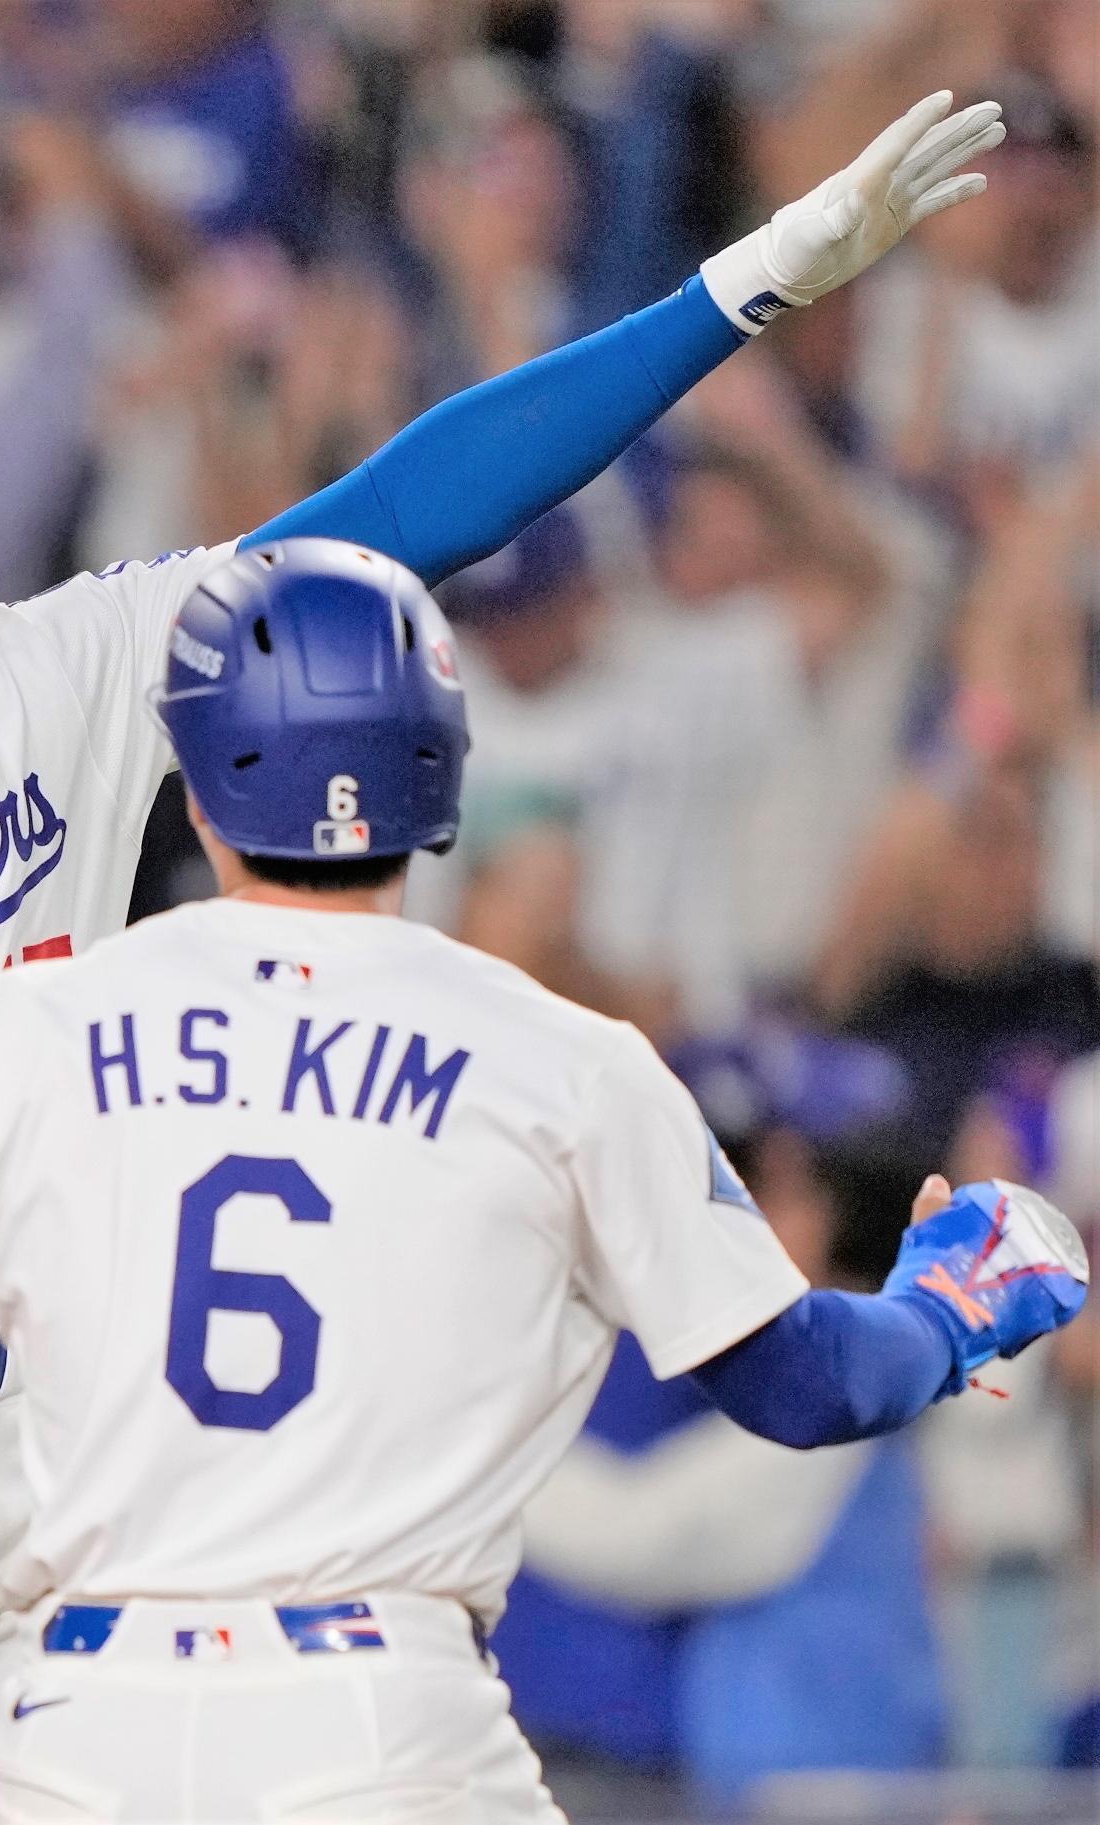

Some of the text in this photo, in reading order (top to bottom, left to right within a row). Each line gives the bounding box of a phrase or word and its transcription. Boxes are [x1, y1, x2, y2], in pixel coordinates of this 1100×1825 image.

[327, 775, 359, 821] 6
[88, 1008, 471, 1140] H.S. KIM
[165, 1154, 332, 1432] 6
